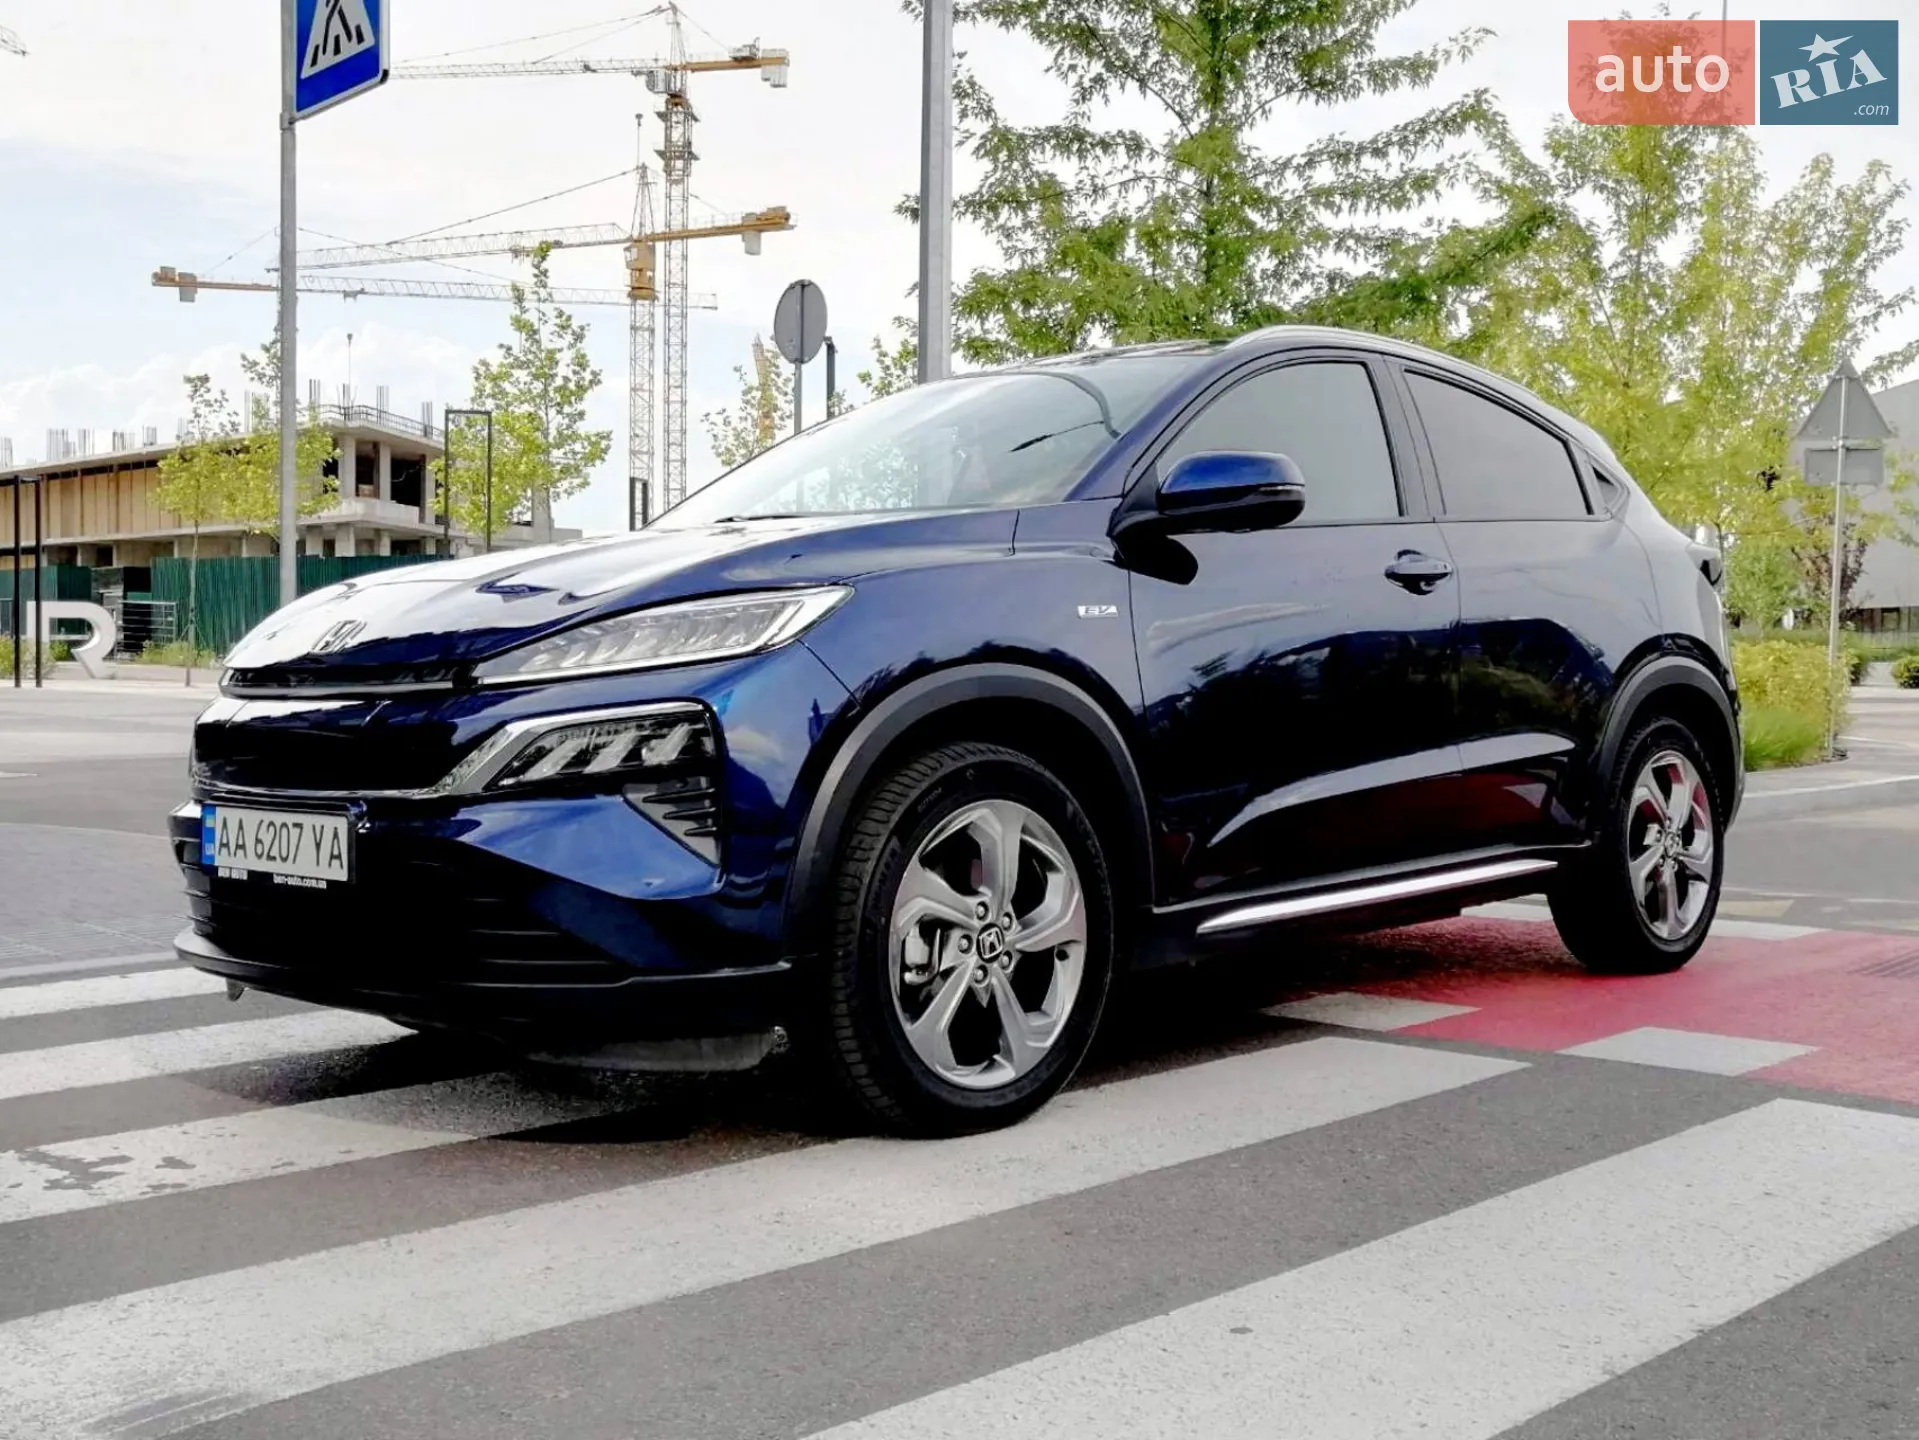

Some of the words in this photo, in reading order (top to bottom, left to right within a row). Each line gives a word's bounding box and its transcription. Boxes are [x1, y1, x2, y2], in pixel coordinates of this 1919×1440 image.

[217, 816, 248, 860] AA
[253, 819, 304, 865] 6207
[312, 823, 344, 870] YA
